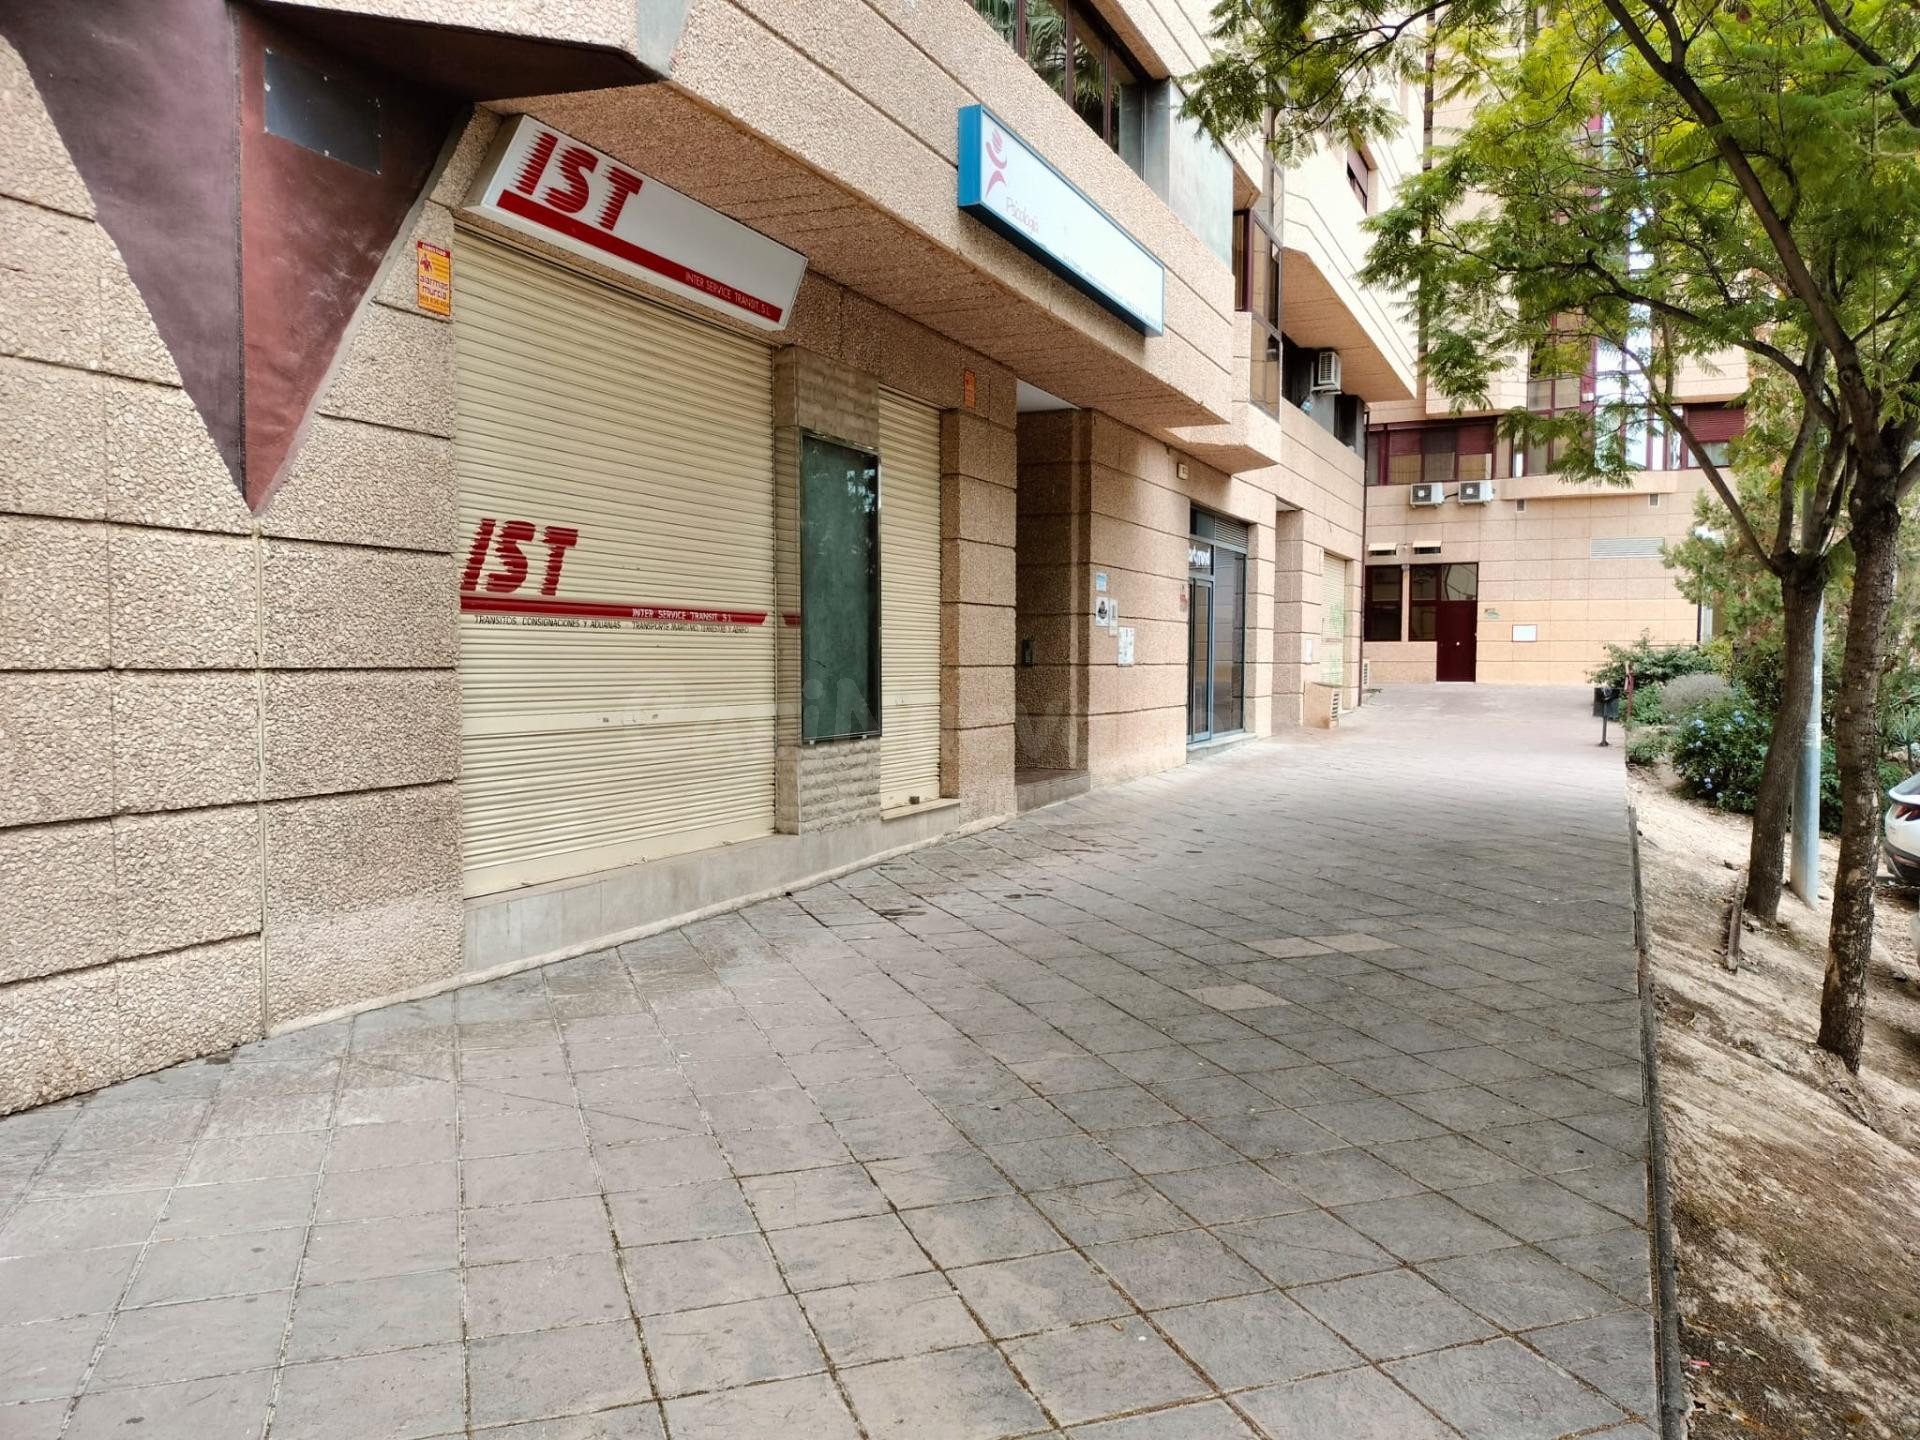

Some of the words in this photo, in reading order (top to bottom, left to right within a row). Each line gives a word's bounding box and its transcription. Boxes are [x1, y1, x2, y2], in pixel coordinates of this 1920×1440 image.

[510, 130, 644, 231] IST
[420, 275, 448, 290] alarmas
[685, 271, 705, 287] INTER
[706, 280, 732, 299] SERVICE
[423, 285, 447, 300] murcia
[460, 518, 579, 596] IST
[632, 608, 653, 618] INTER
[658, 609, 686, 620] SERVICE
[690, 611, 718, 621] TRANSIT
[522, 617, 580, 627] CONSIGNACIONES
[583, 620, 588, 628] Y
[590, 620, 621, 629] ADUANAS
